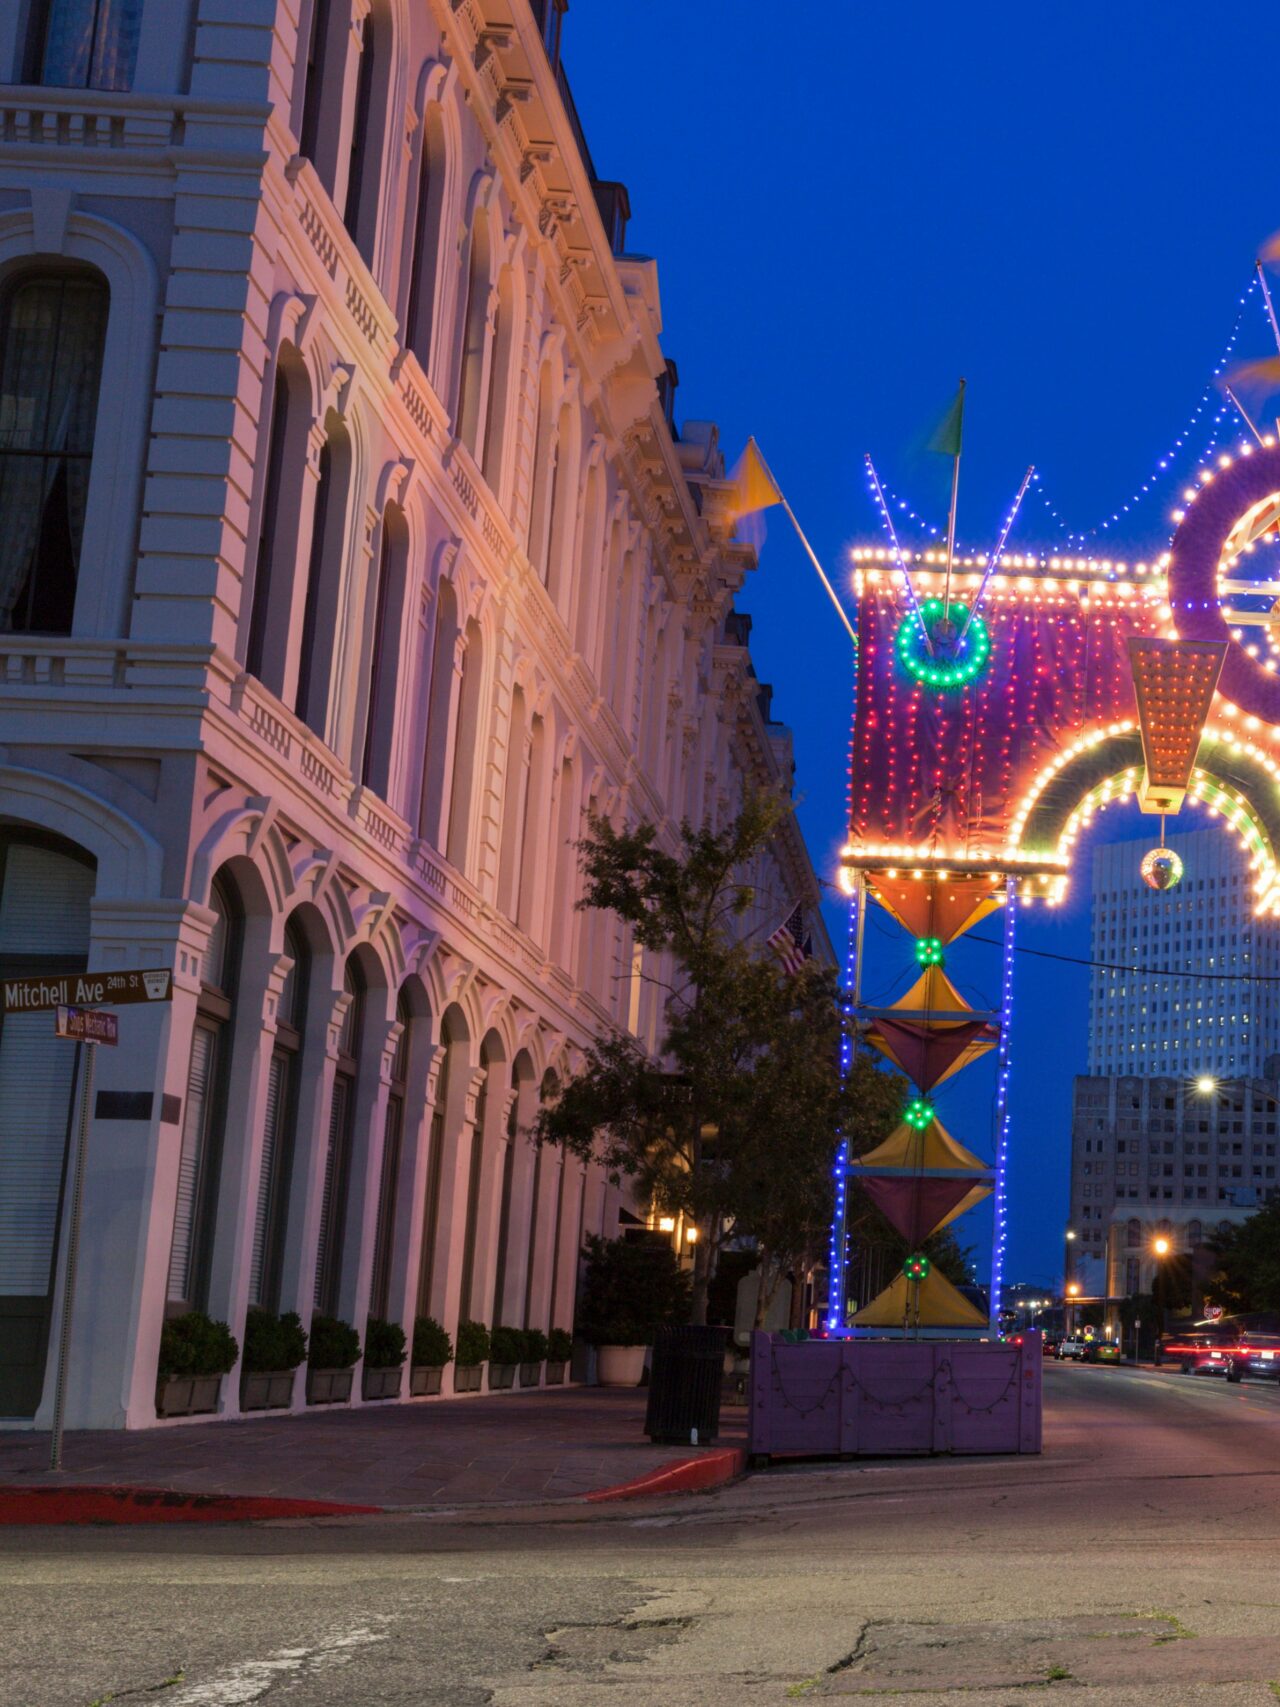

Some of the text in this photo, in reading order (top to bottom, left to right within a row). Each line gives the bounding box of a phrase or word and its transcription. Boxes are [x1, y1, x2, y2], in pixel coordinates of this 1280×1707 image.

[5, 974, 139, 1008] Mitchell Ave 24th St
[1205, 1306, 1221, 1315] OP
